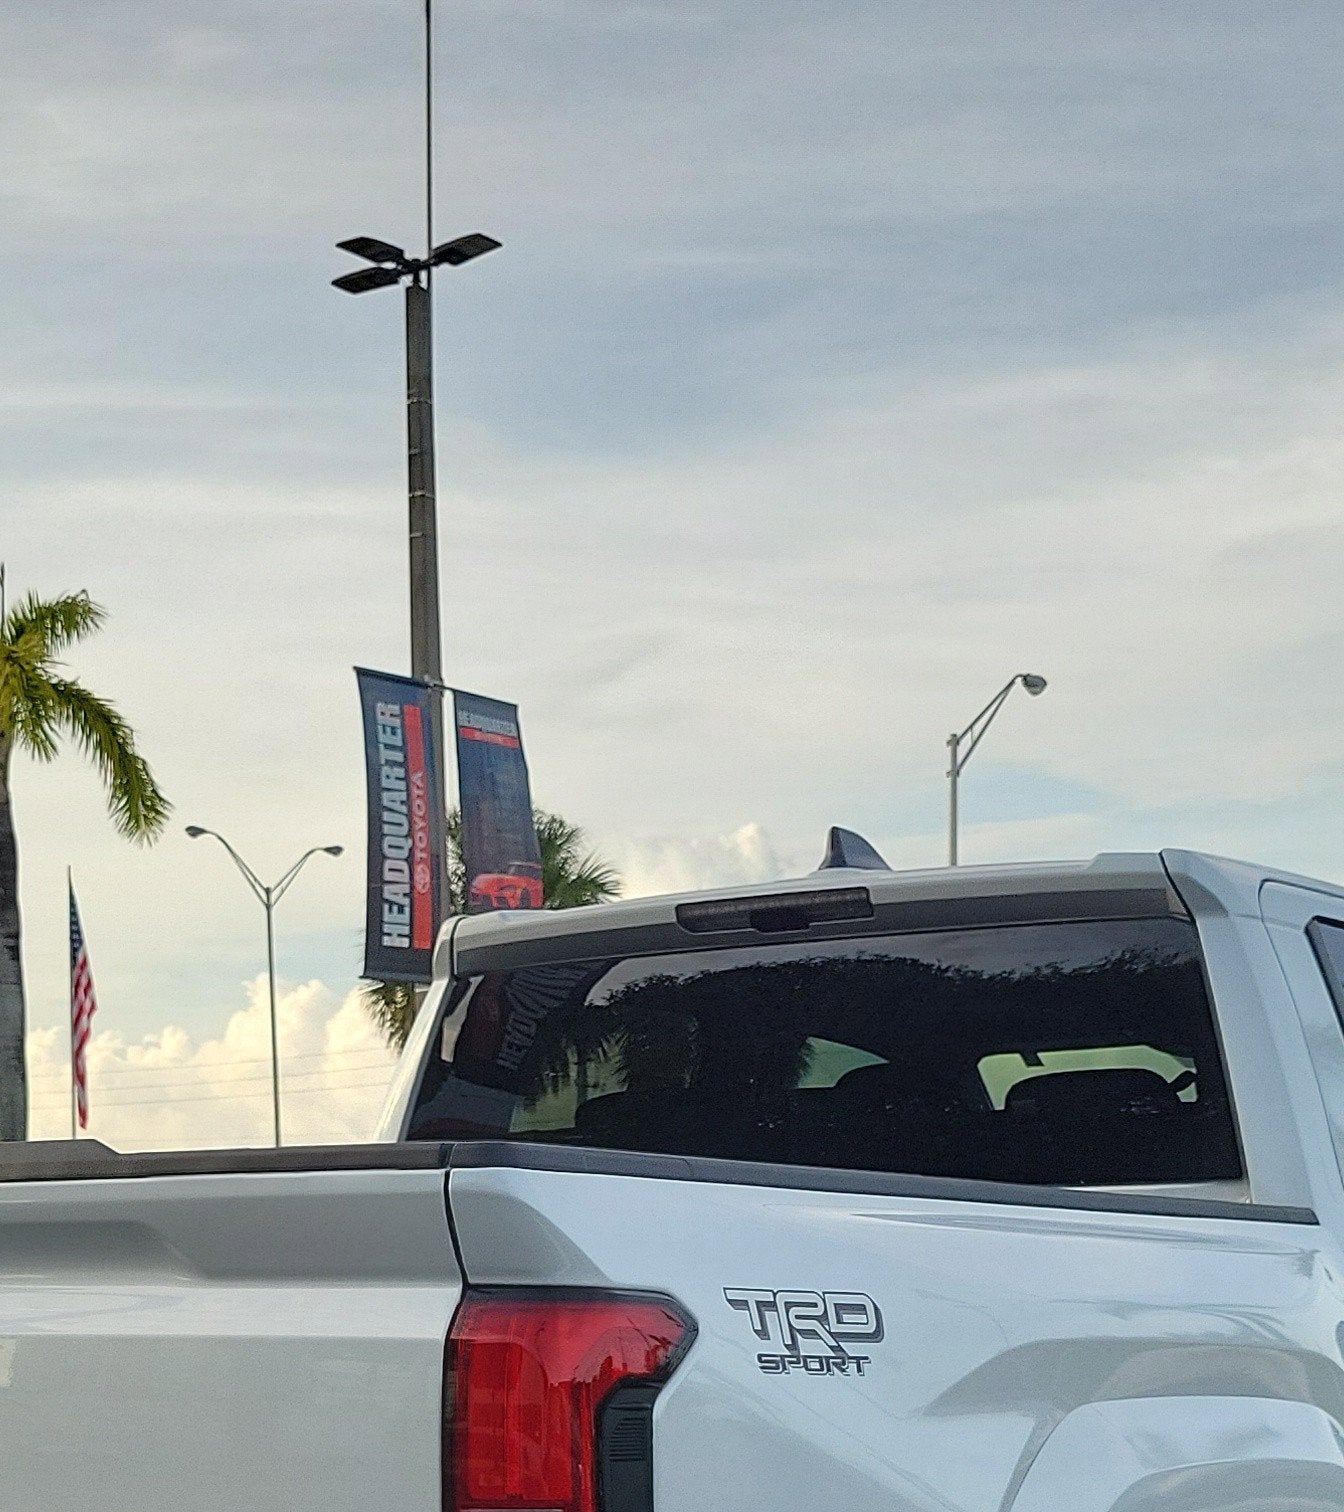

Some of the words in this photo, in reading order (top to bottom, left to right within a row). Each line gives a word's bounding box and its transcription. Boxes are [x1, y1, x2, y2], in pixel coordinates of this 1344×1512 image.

[376, 702, 413, 949] HEADQUARTER
[410, 772, 429, 862] TOYOTA
[723, 1287, 885, 1357] TRD
[757, 1353, 872, 1377] SPORT
